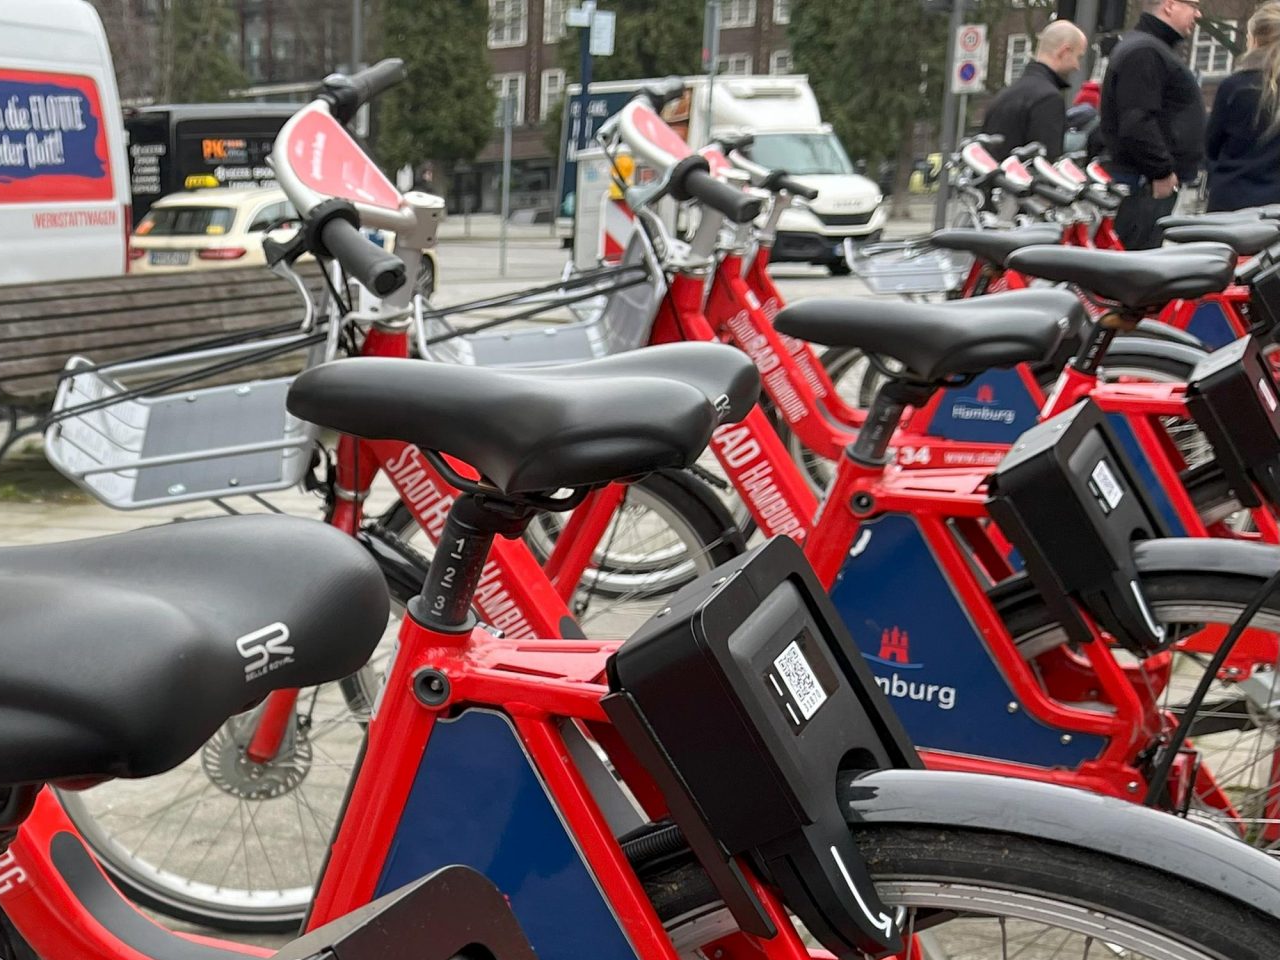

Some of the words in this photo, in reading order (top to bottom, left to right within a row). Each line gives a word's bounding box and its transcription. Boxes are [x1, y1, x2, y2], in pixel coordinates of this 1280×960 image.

[952, 404, 1016, 425] Hamburg
[455, 538, 465, 553] 1
[444, 567, 456, 582] 2
[434, 595, 446, 610] 3
